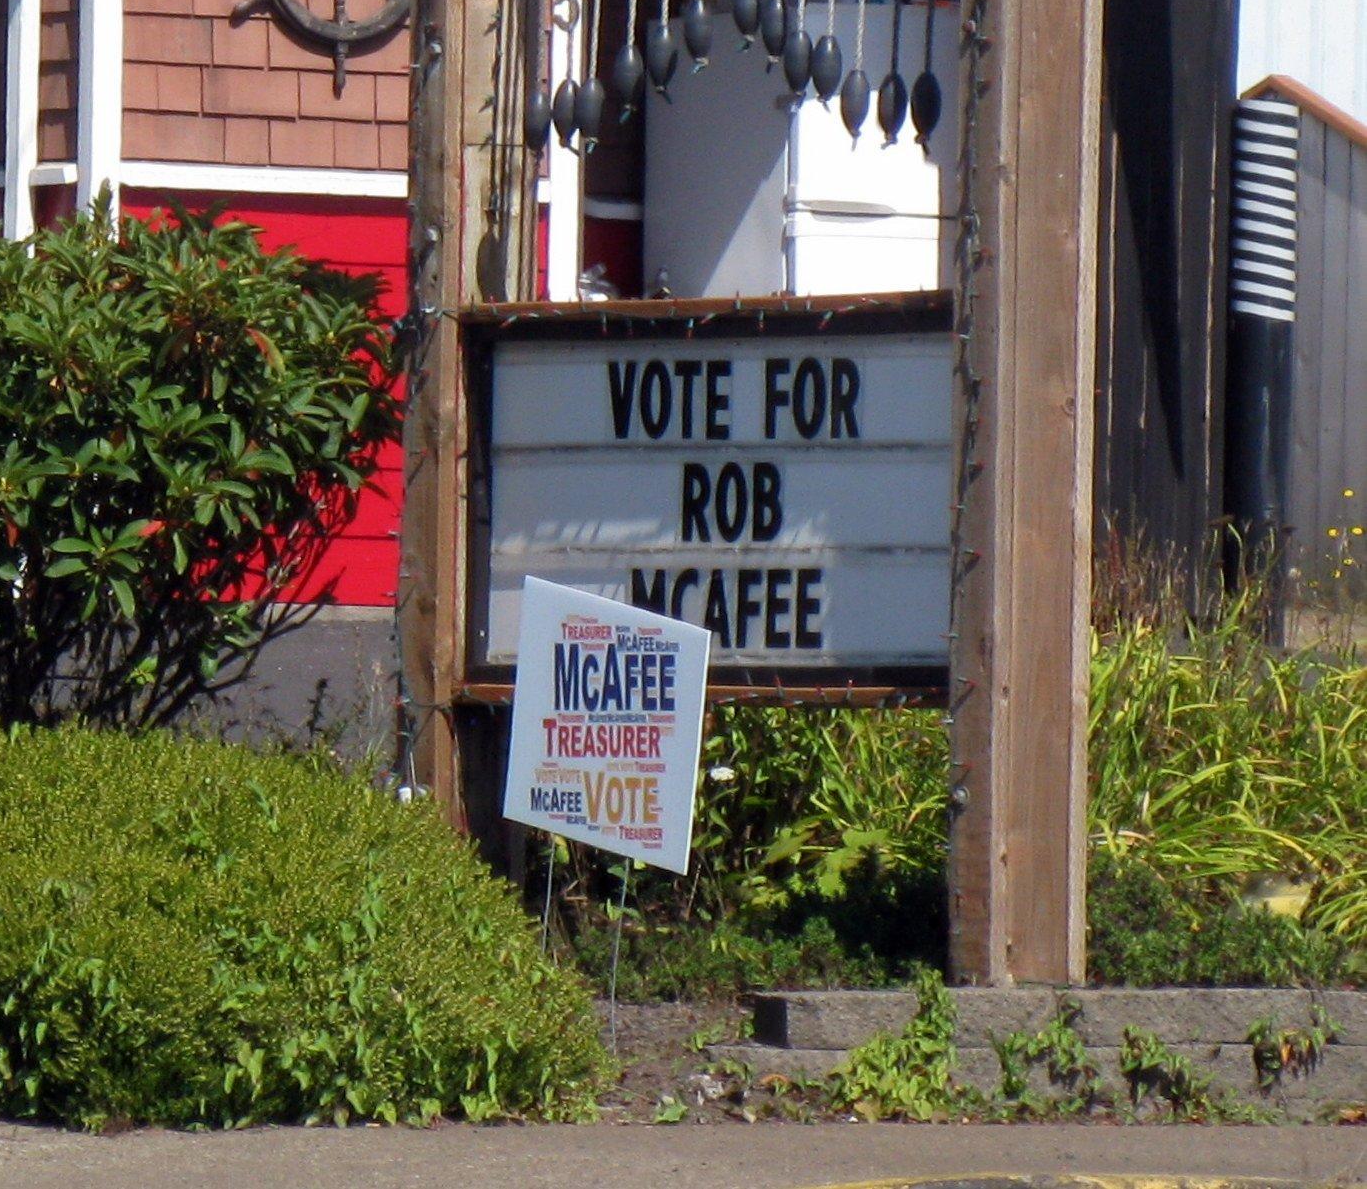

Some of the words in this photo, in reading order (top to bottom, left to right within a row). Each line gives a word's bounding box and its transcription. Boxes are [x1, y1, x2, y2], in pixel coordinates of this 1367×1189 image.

[607, 359, 732, 440] VOTE
[764, 357, 860, 440] FOR
[681, 462, 784, 543] ROB
[542, 718, 661, 758] TREASURER
[583, 770, 659, 824] VOTE
